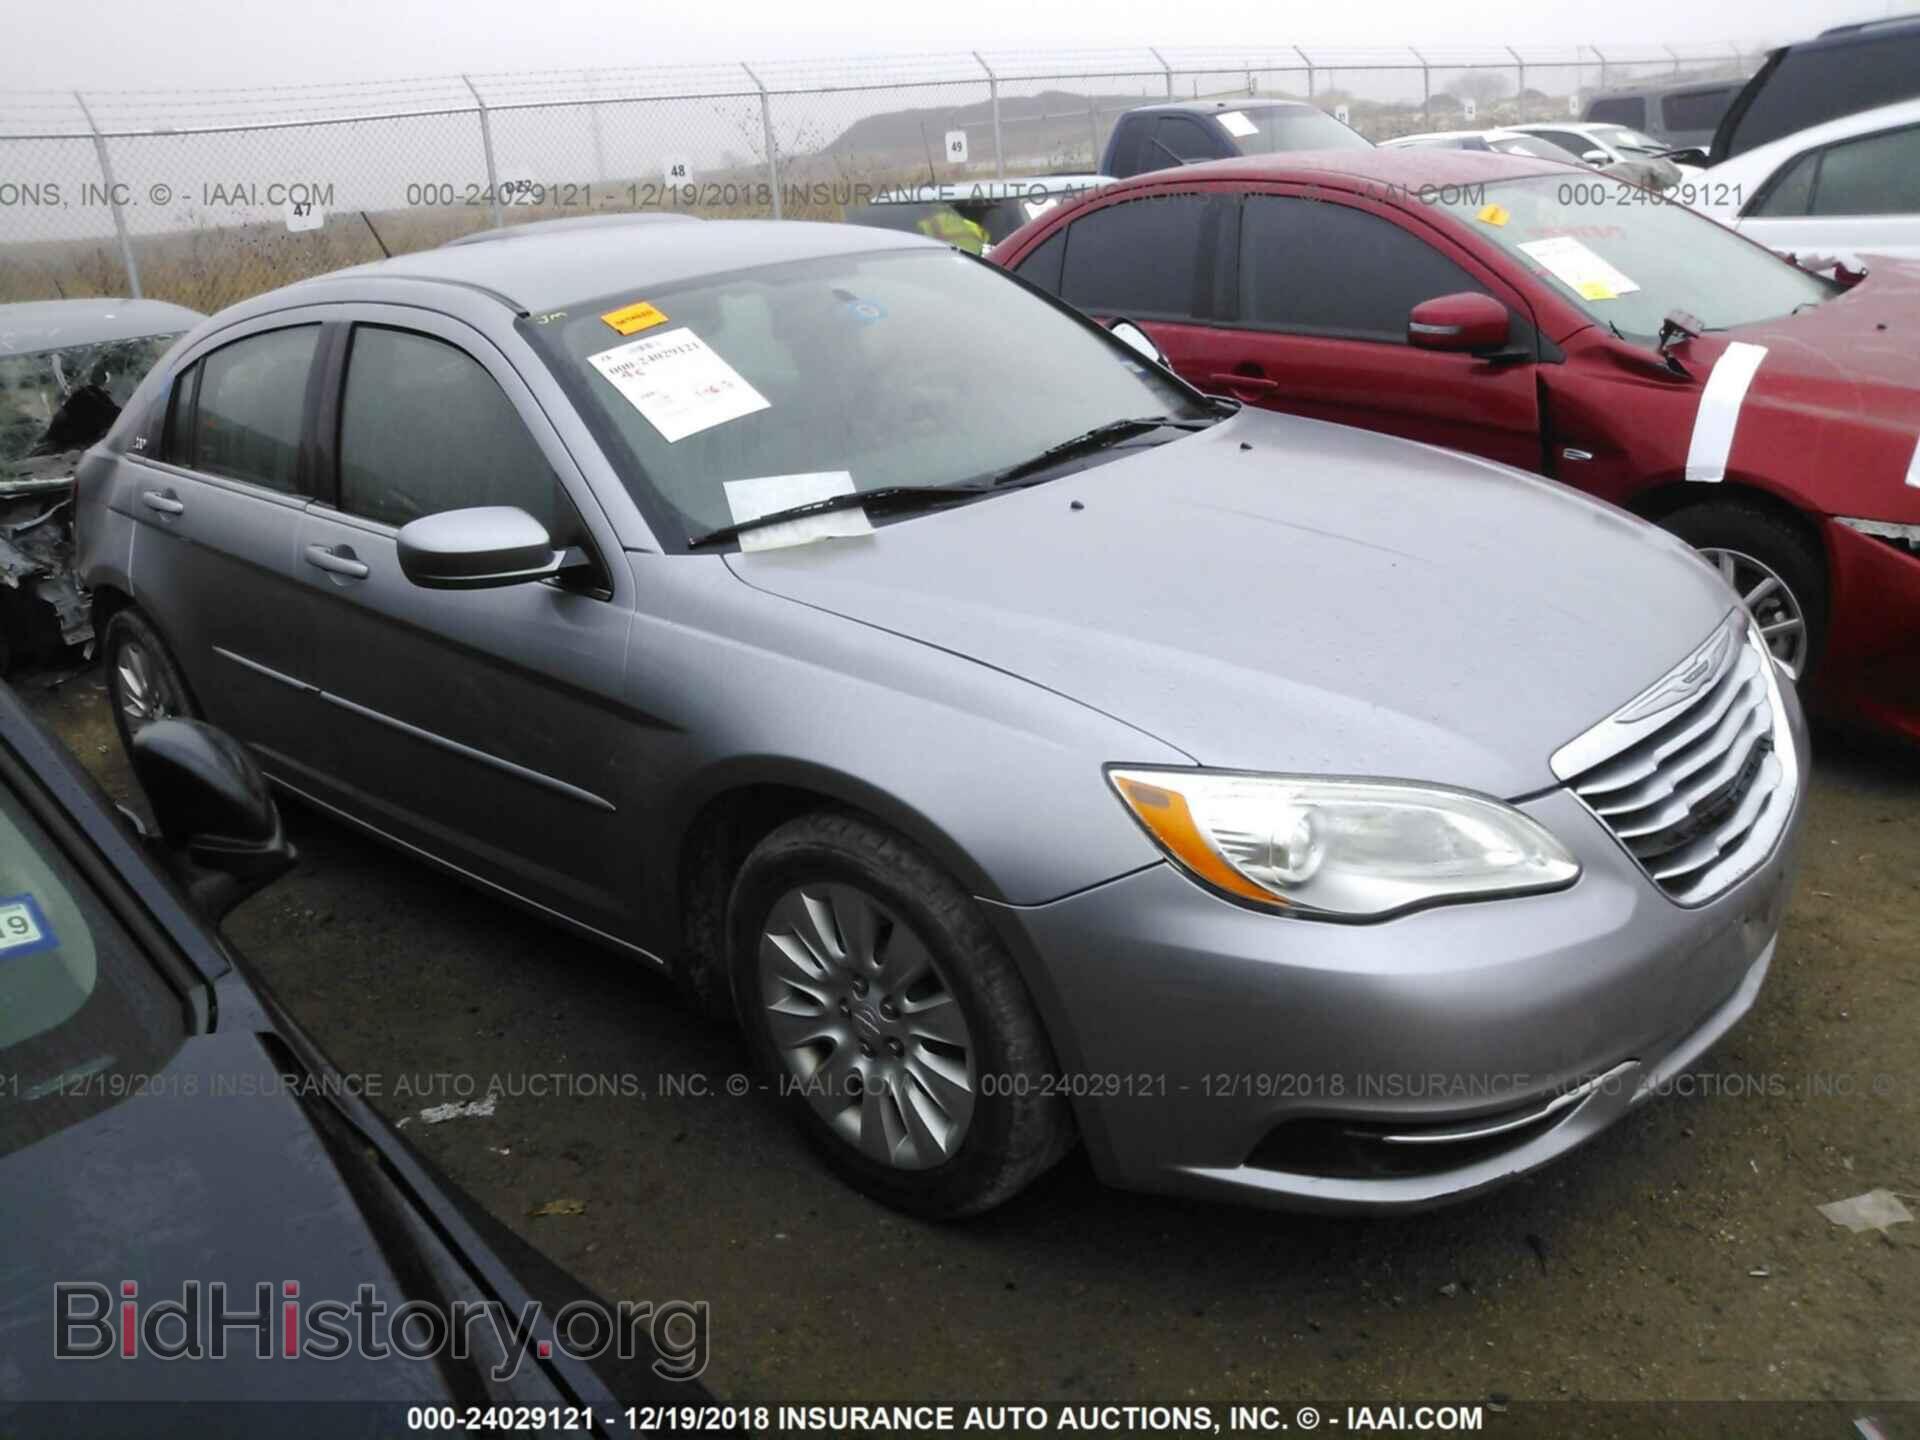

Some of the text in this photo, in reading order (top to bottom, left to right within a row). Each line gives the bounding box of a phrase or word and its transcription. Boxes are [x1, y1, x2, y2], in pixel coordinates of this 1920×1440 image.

[951, 141, 962, 152] 49
[671, 164, 685, 177] 48
[294, 203, 311, 216] 47
